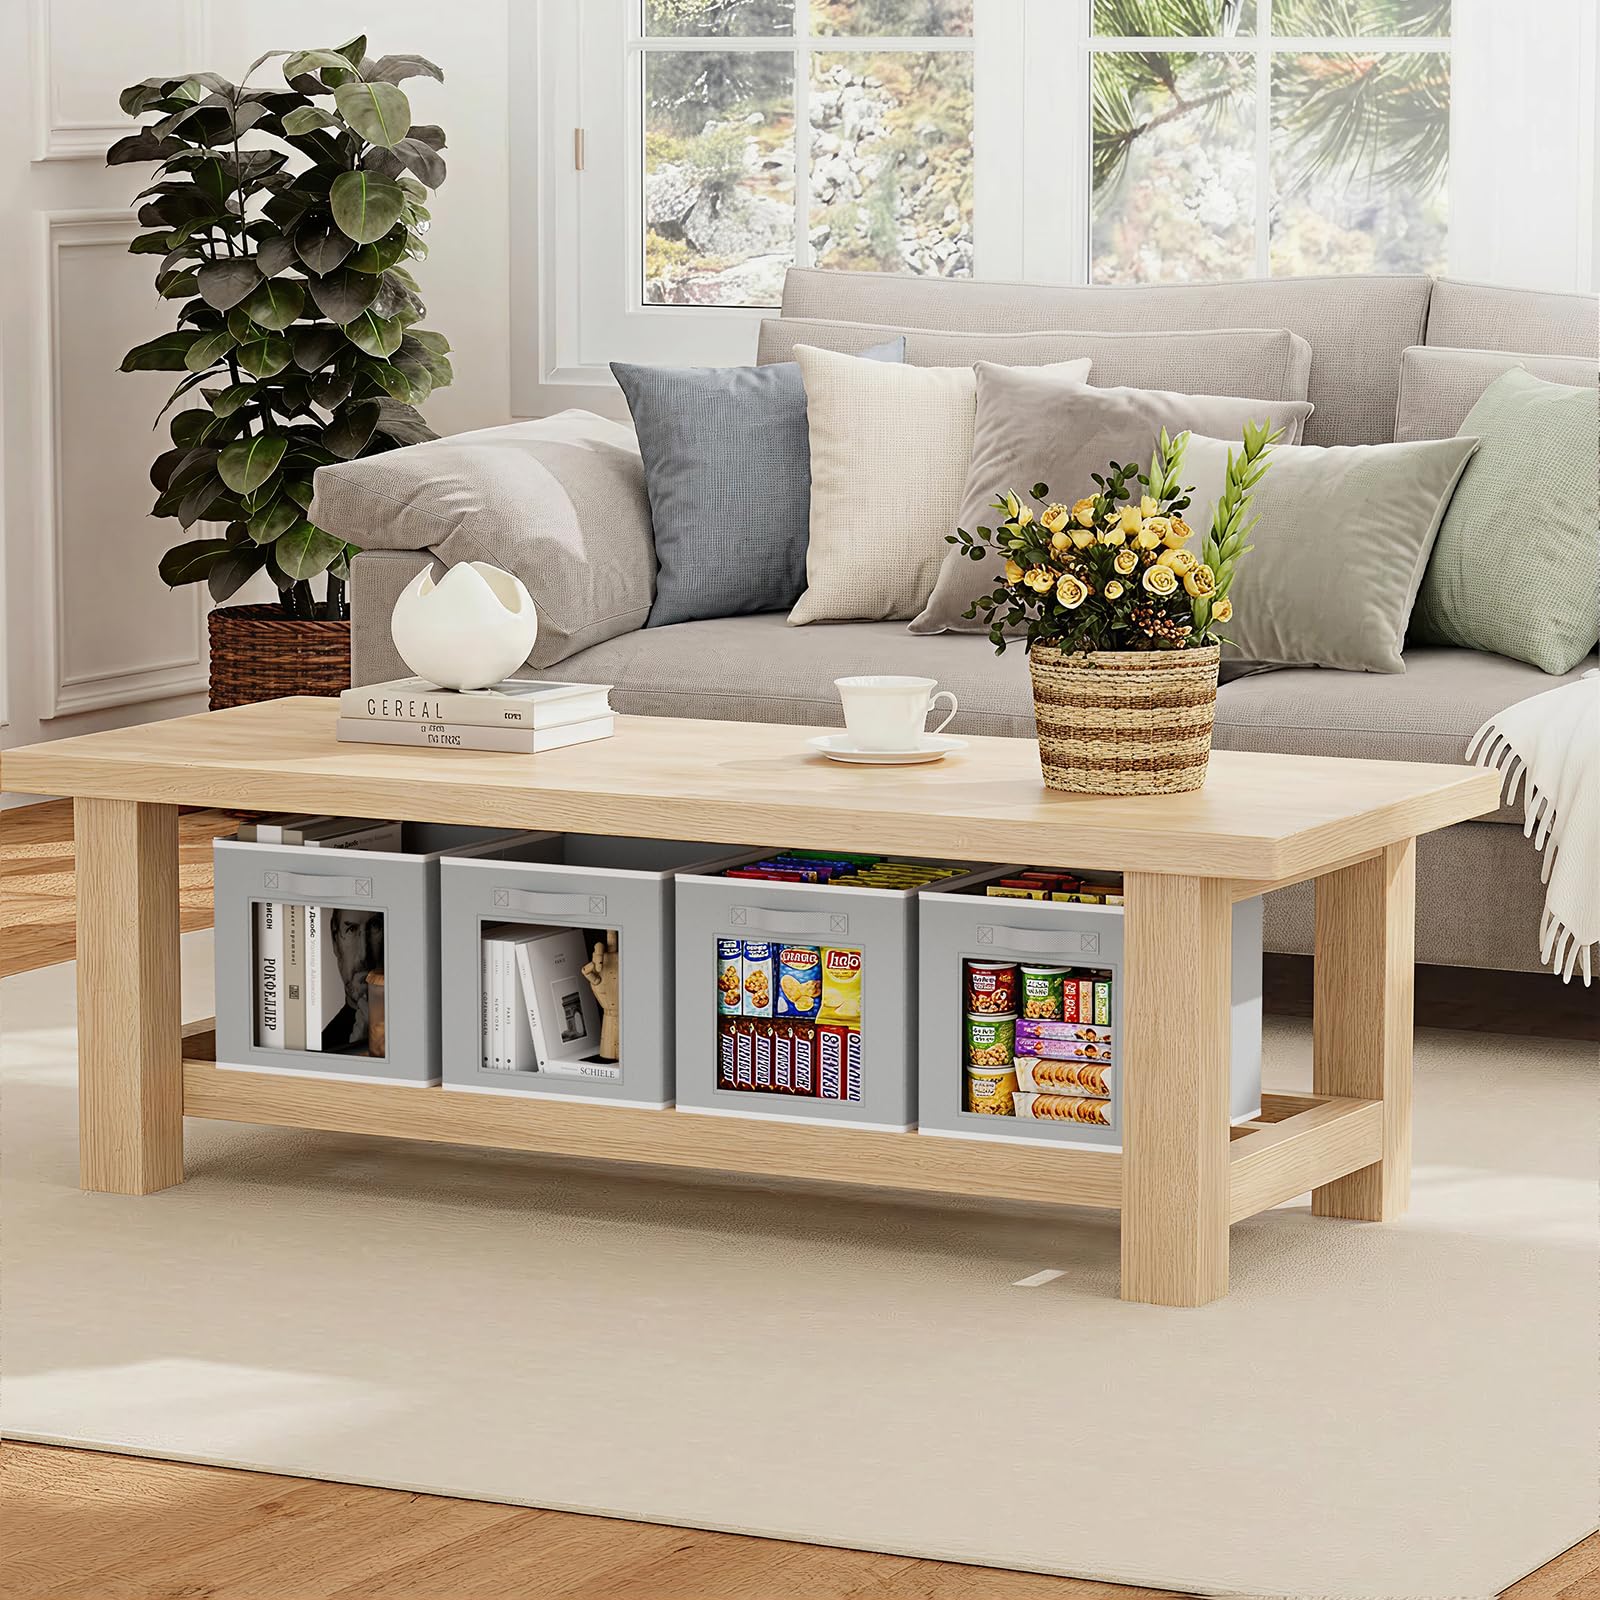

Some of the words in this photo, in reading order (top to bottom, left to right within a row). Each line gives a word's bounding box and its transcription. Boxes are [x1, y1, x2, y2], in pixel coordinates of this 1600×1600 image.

[309, 911, 317, 938] Джобс
[263, 958, 277, 1031] РОКФЕЛЛЕР
[579, 1066, 616, 1079] SCHIELE
